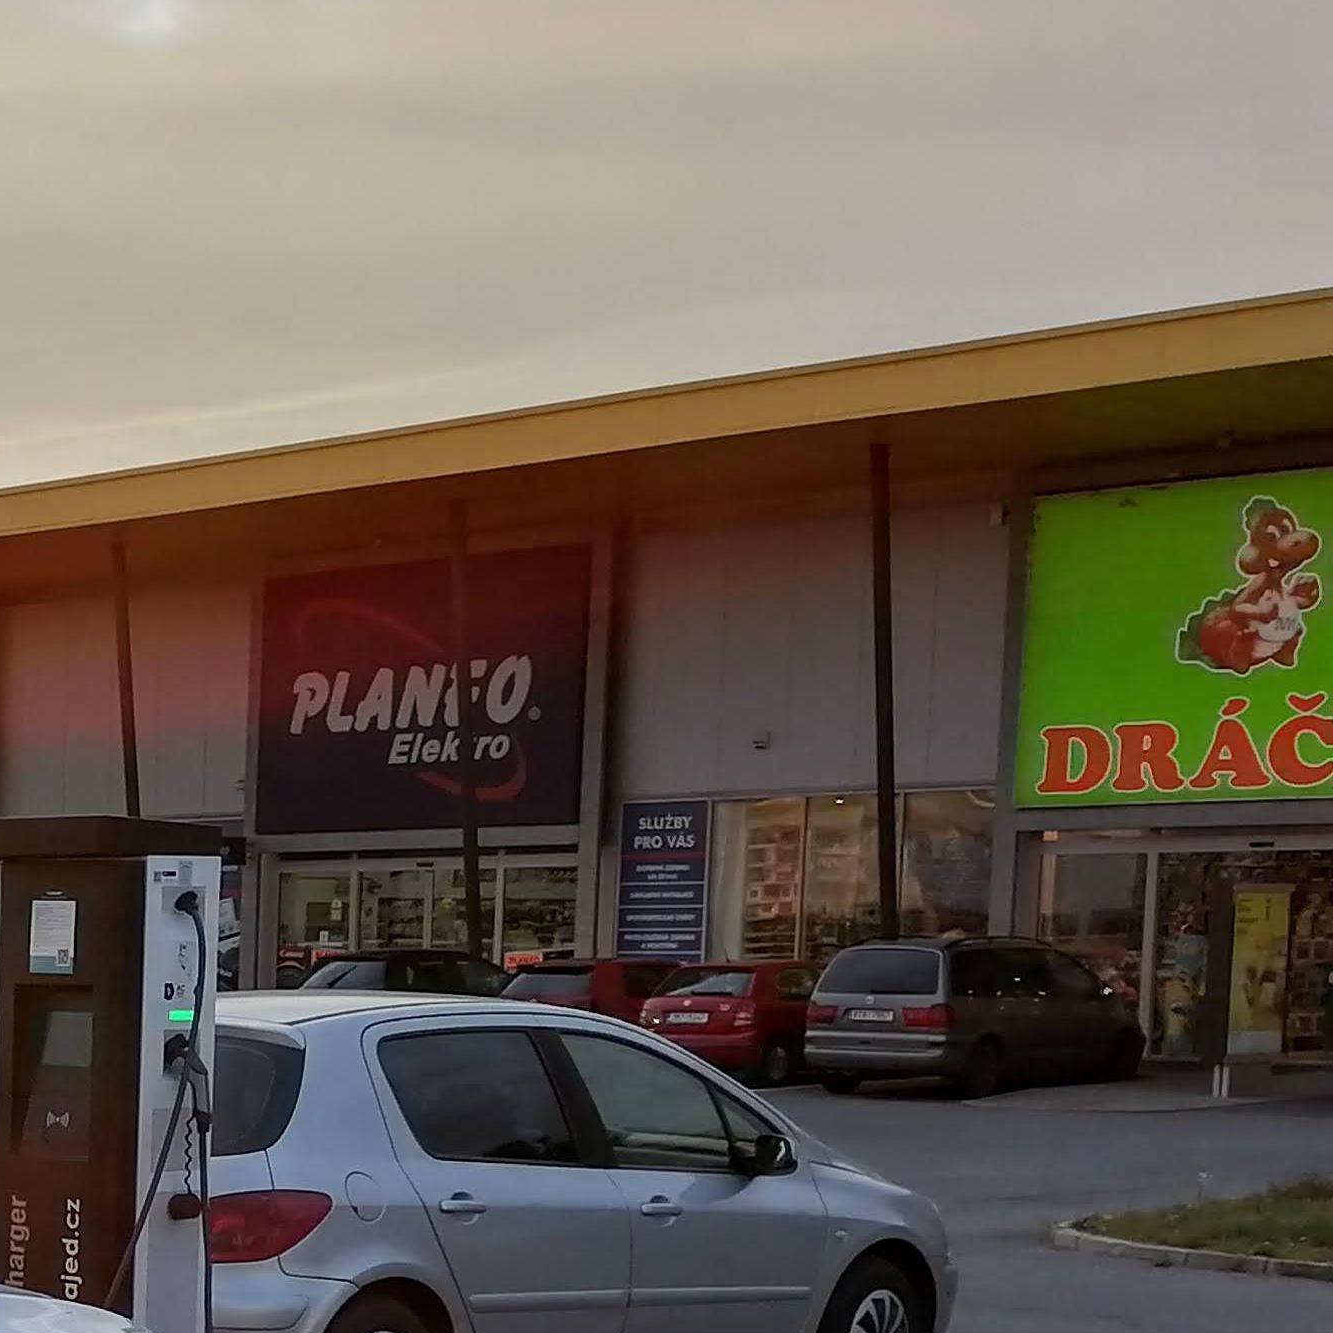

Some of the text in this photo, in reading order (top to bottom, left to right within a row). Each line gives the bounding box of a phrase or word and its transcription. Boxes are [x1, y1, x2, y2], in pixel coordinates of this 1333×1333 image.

[388, 730, 511, 765] Elekro
[1036, 691, 1333, 795] DRÁČ
[637, 812, 693, 831] SLUŽBY
[633, 832, 696, 850] PRO VÁS
